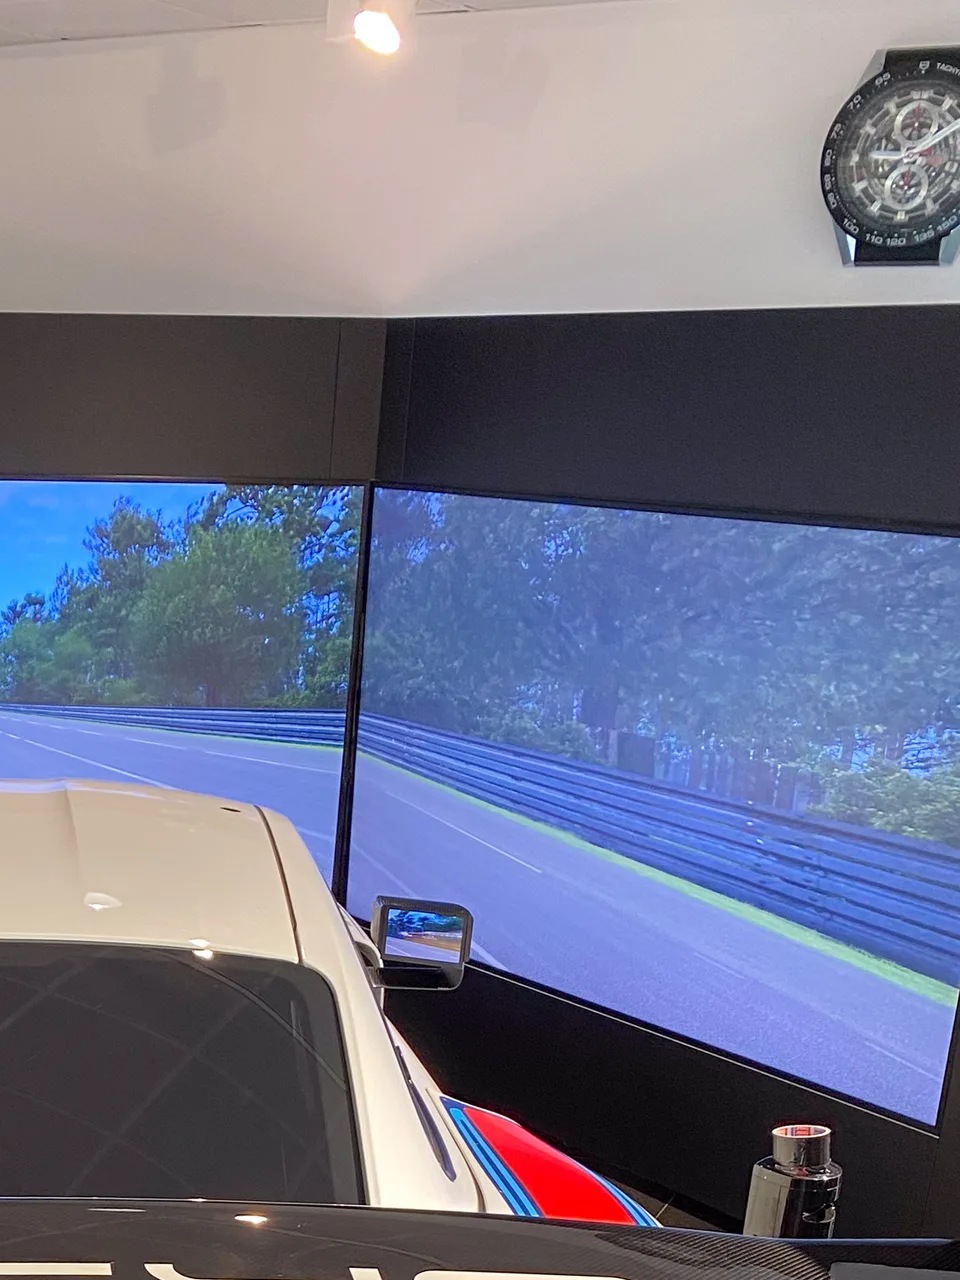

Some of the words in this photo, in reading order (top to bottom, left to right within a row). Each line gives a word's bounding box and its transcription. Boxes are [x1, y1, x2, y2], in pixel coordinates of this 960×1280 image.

[847, 95, 862, 110] 70
[843, 218, 860, 234] 100
[936, 215, 958, 231] 150
[865, 233, 883, 244] 110
[885, 237, 906, 246] 120
